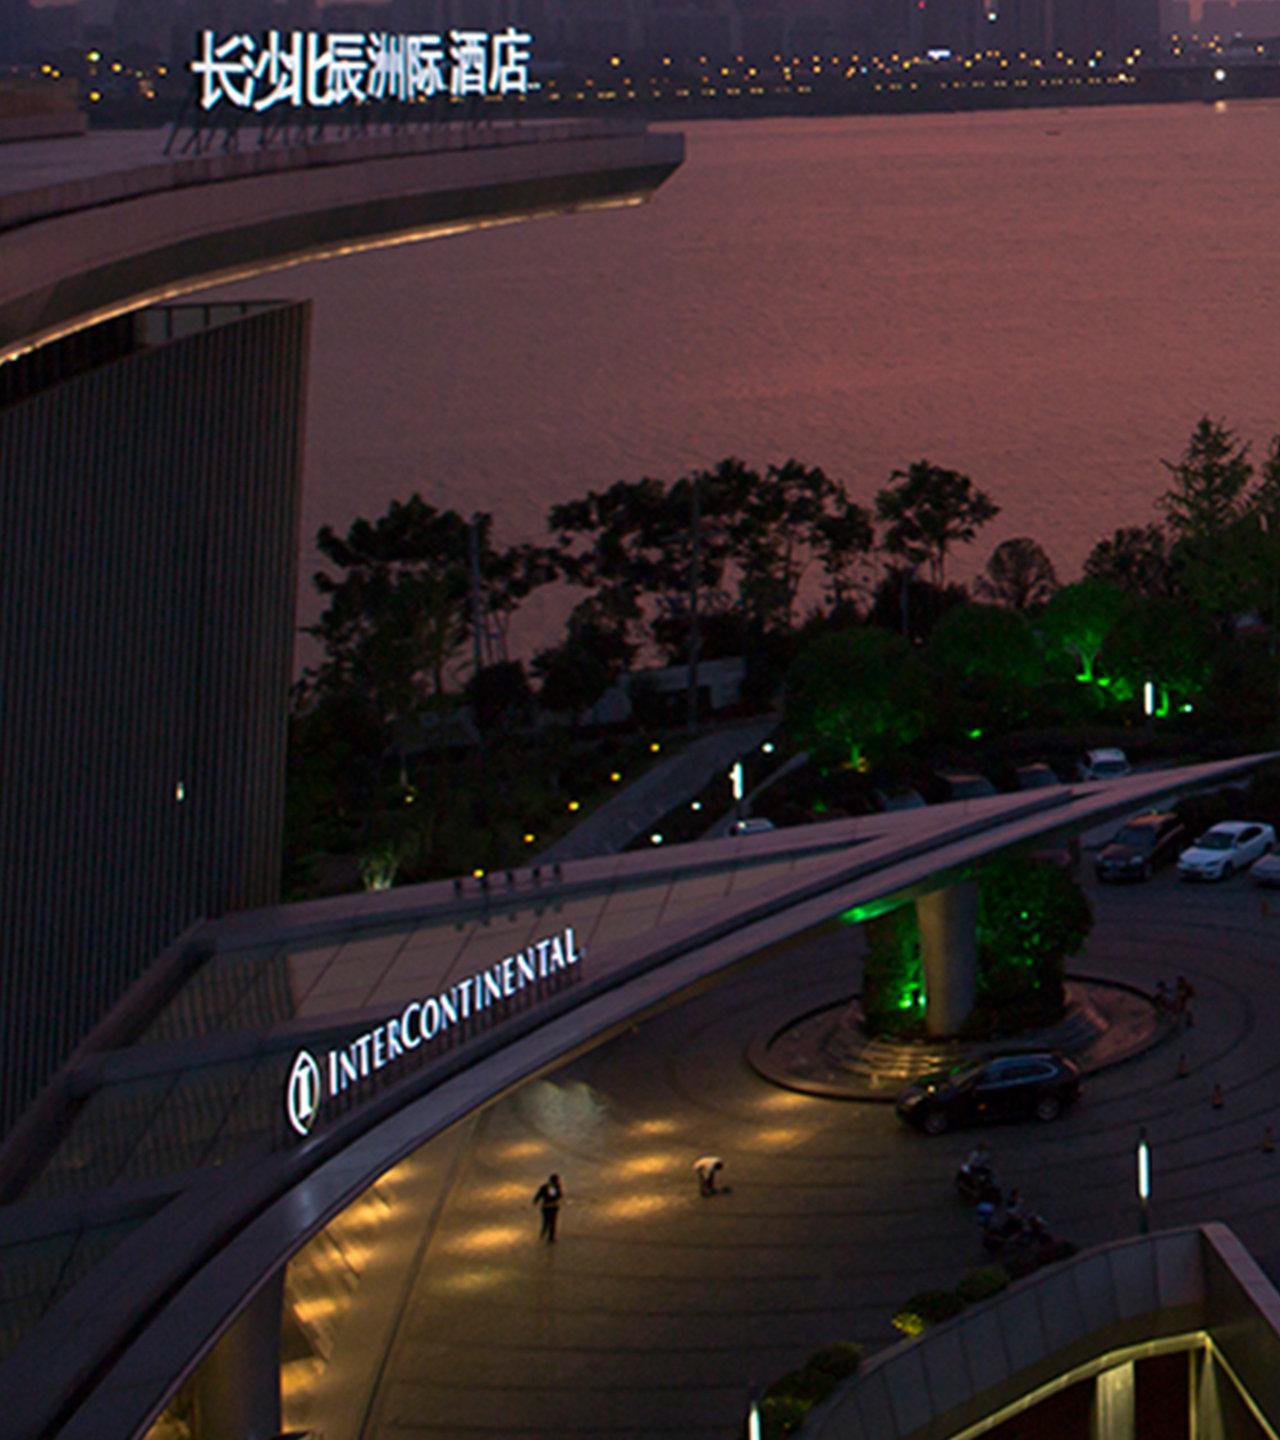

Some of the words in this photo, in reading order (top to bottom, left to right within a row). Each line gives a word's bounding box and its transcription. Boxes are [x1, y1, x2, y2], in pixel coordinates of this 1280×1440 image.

[190, 27, 533, 111] 长沙北辰洲际酒店
[329, 927, 580, 1097] INTERCONTINENTAL
